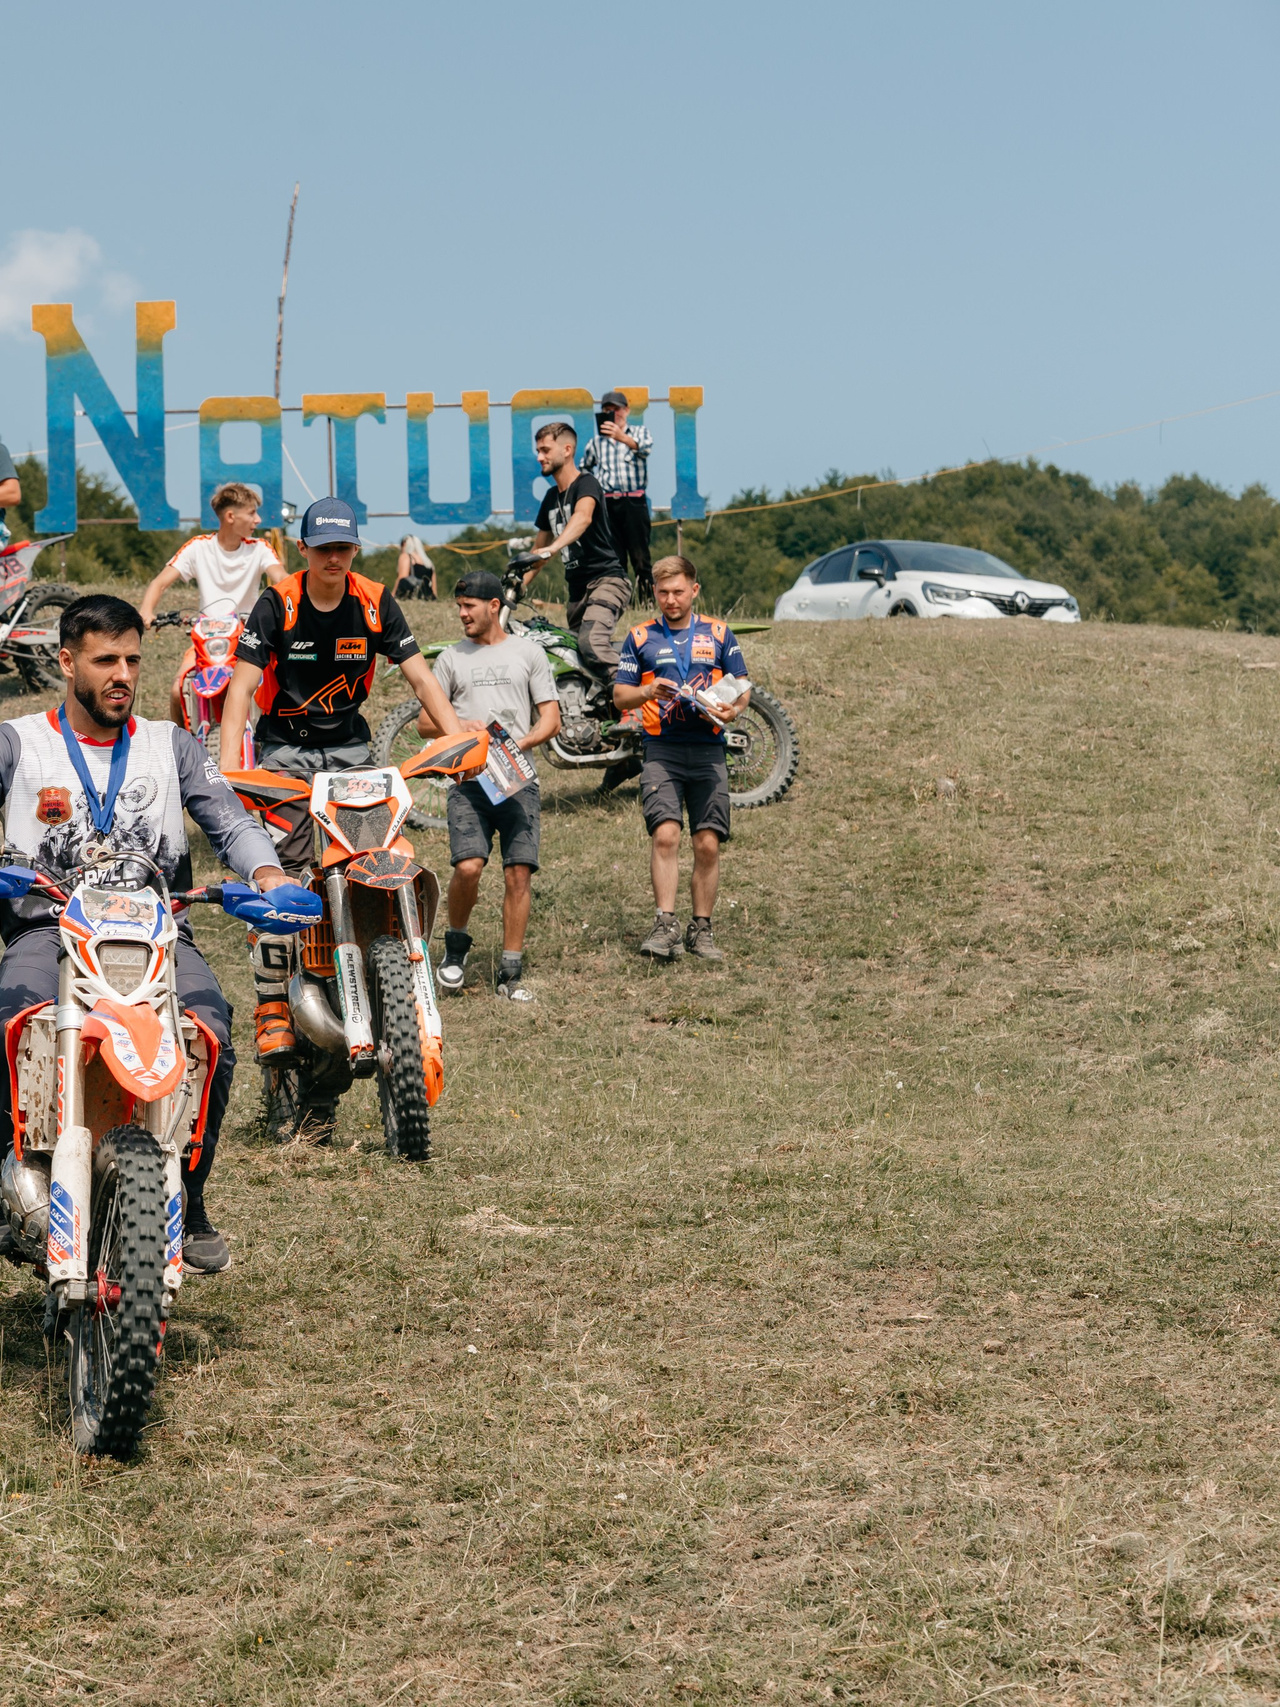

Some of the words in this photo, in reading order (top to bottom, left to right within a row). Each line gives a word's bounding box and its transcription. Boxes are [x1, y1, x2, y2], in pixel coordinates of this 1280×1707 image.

[471, 665, 510, 680] EA7
[504, 738, 534, 779] OFF-ROAD
[347, 779, 373, 794] 50
[315, 810, 331, 826] KTM
[50, 1208, 67, 1224] SKF
[52, 1229, 70, 1249] LIQUI
